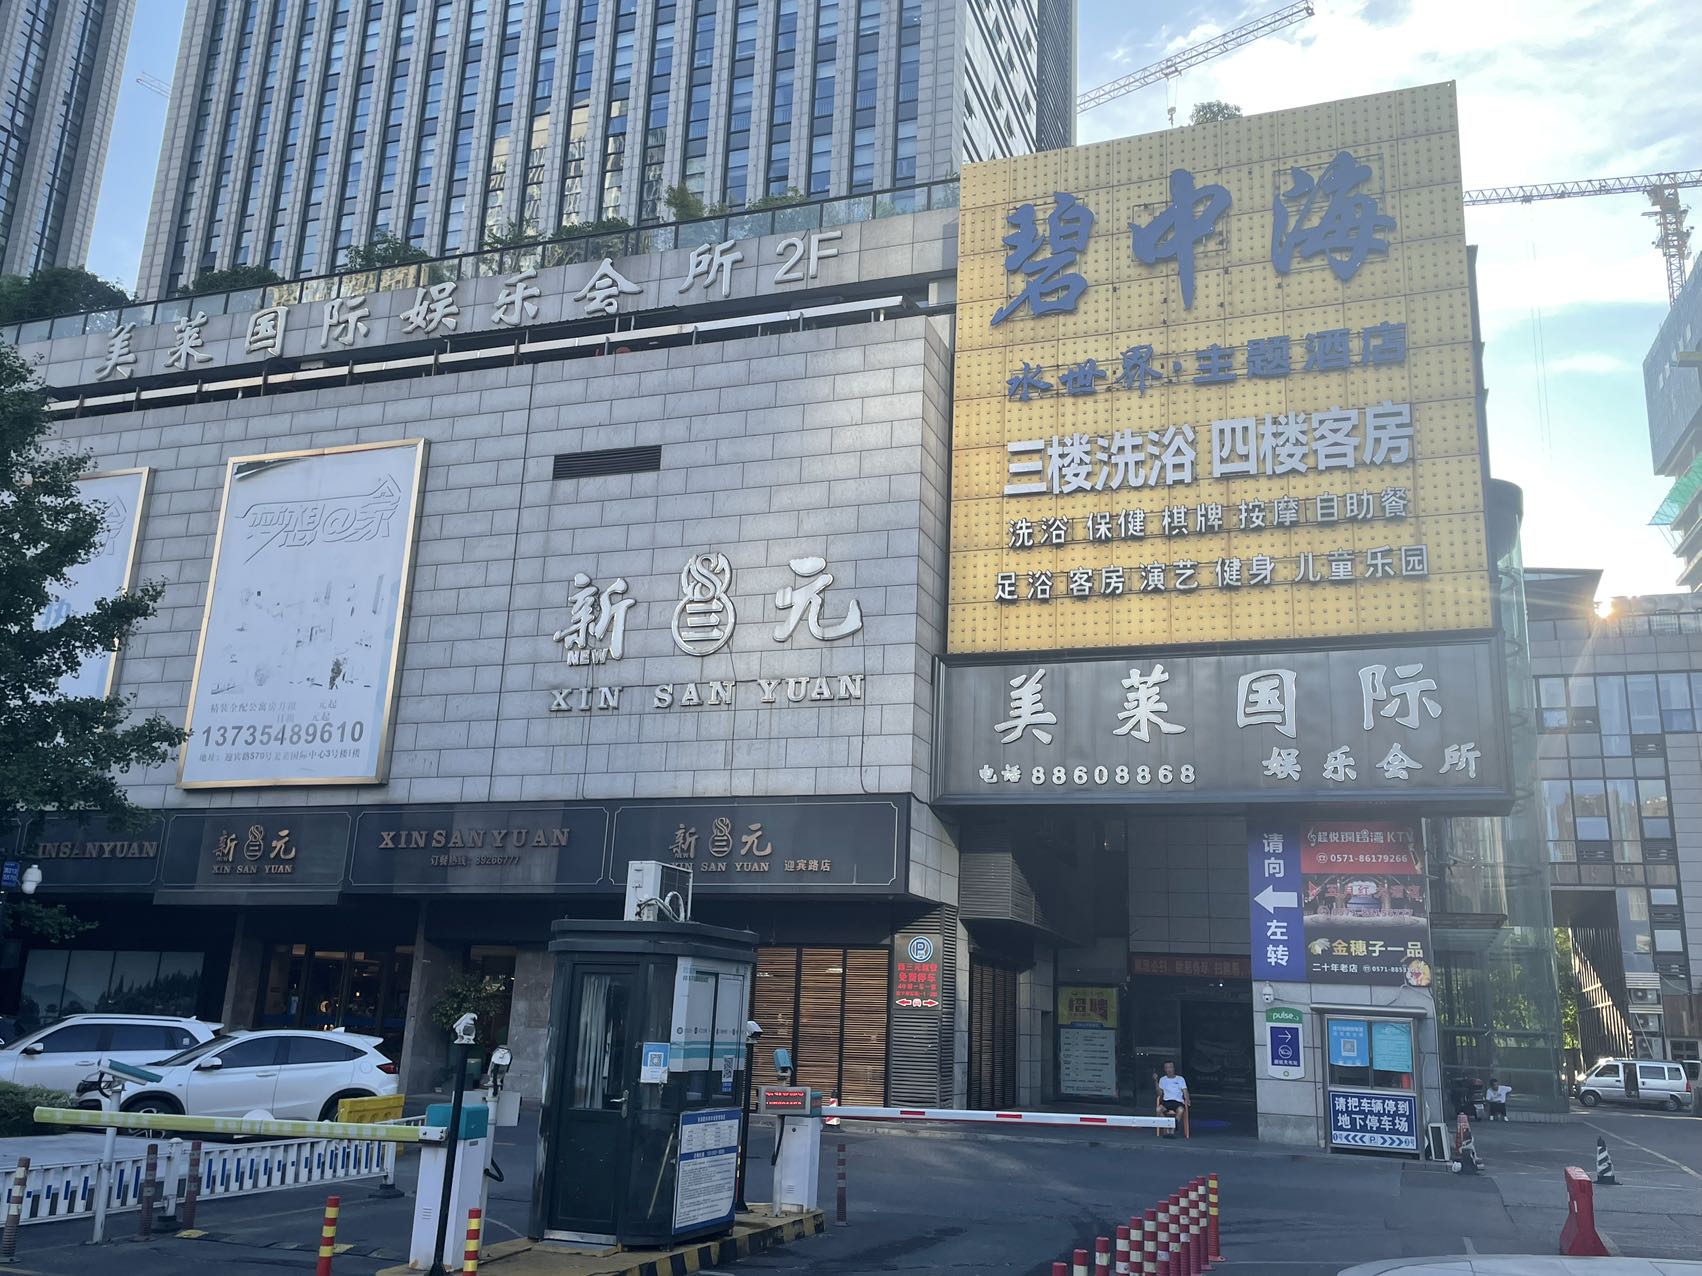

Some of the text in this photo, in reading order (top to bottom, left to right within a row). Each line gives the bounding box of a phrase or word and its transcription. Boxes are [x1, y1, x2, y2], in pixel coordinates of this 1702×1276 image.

[990, 151, 1397, 326] 碧中海
[96, 230, 842, 381] 美莱国际娱乐会所 2F
[1004, 401, 1414, 497] 三楼洗浴 四楼客房
[1007, 487, 1410, 549] 洗浴 保健 棋牌 按摩 自助餐
[994, 544, 1429, 601] 足浴 客房 演艺 健身 儿童乐园
[566, 648, 607, 666] NEW
[550, 674, 865, 711] XIN SAN YUAN
[993, 662, 1444, 745] 美莱国际
[202, 720, 364, 747] 13735489610
[1261, 742, 1482, 783] 娱乐会所
[978, 763, 1196, 786] 电话 88608868
[378, 828, 571, 849] XINSANYUAN
[1387, 831, 1414, 843] KTV
[37, 841, 158, 858] INSANYUAN
[1262, 832, 1286, 878] 请向
[1330, 854, 1408, 863] 0571-86179266
[211, 865, 293, 874] XIN SAN YUAN
[701, 862, 726, 872] SAN
[735, 862, 770, 872] YUAN
[784, 859, 832, 872] 迎宾路店
[1266, 919, 1289, 967] 左转
[1331, 939, 1424, 958] 金穗子一品
[1312, 963, 1358, 973] 二十年老店
[1272, 1010, 1294, 1020] pulse
[1334, 1096, 1410, 1116] 请把车辆停到
[1337, 1113, 1409, 1133] 地下停车场
